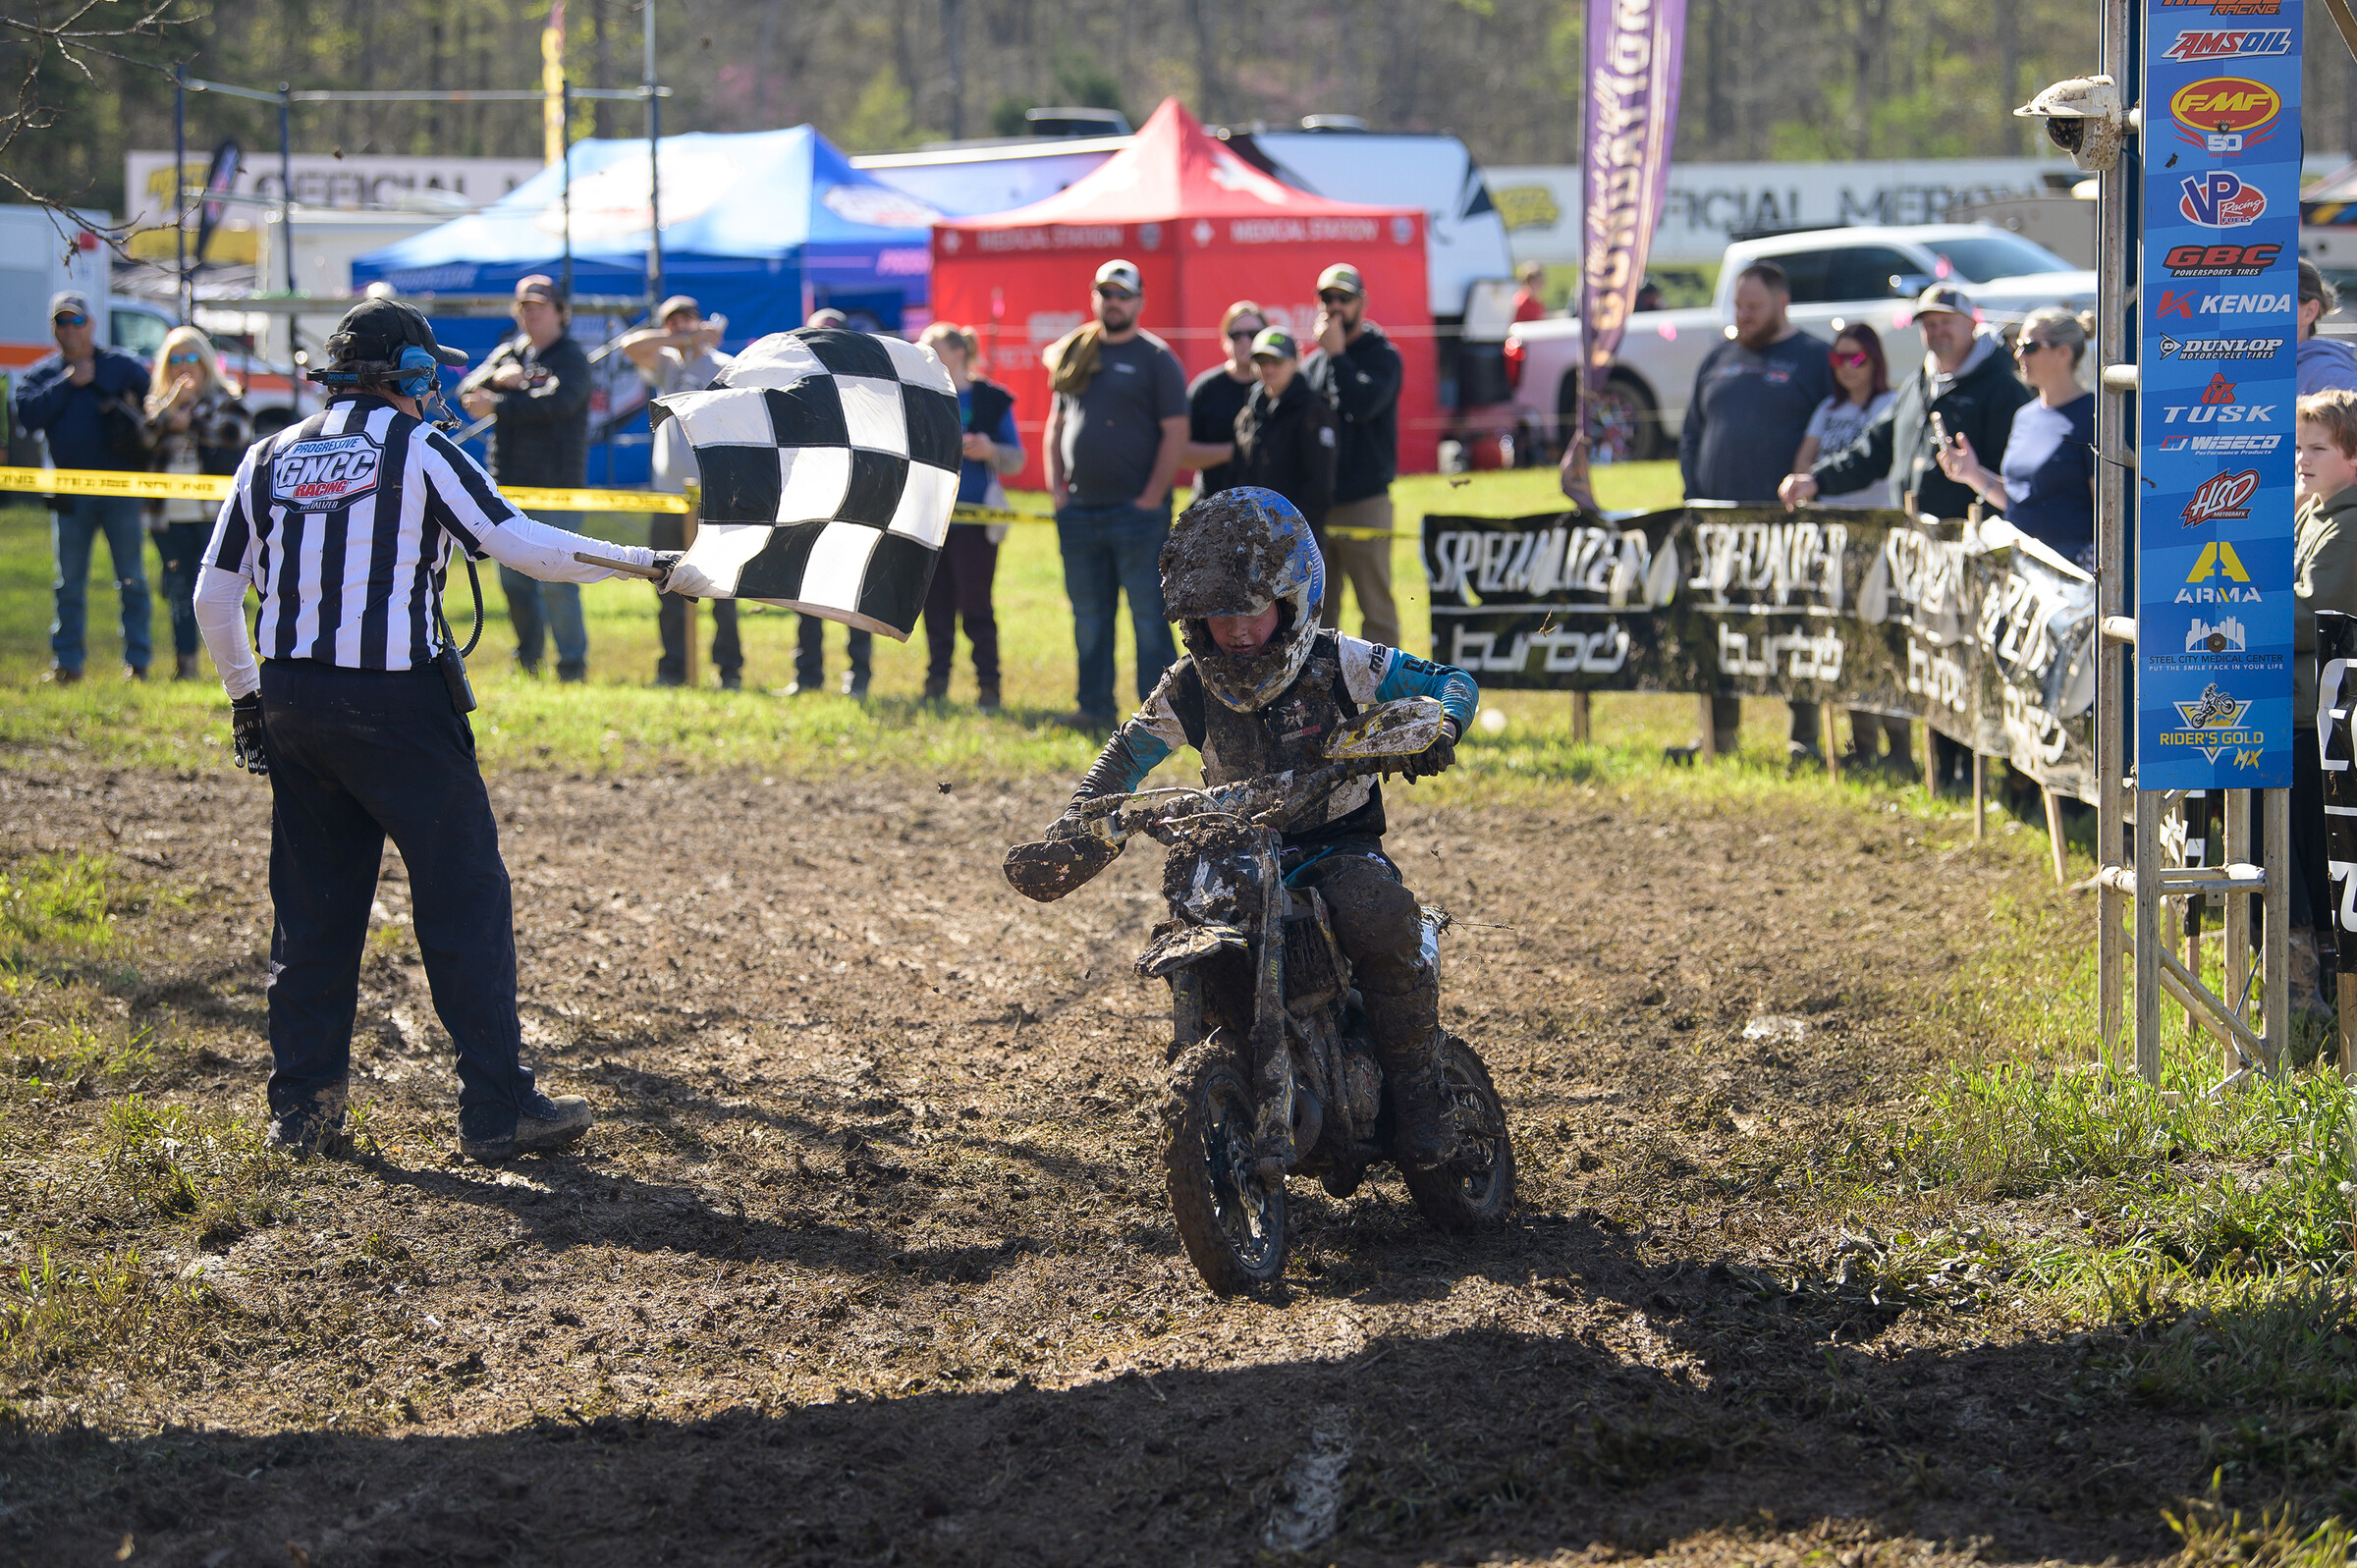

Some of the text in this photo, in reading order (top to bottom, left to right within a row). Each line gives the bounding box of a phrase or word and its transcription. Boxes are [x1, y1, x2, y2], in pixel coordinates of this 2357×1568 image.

[2211, 4, 2279, 15] RACING
[2165, 29, 2291, 62] AMSOIL
[2179, 92, 2272, 111] FMF
[2208, 135, 2242, 151] 50
[2181, 172, 2268, 226] VP Racing
[2164, 244, 2281, 267] GBC
[2199, 295, 2290, 313] KENDA
[2182, 339, 2284, 352] DUNLOP
[2179, 351, 2242, 360] MOTORCYCLE
[2163, 405, 2277, 423] TUSK
[293, 437, 359, 455] PROGRESSIVE
[277, 449, 377, 489] GNCC
[294, 479, 349, 498] RACING
[2173, 587, 2263, 604] ARMA
[2178, 655, 2199, 664] CITY
[2246, 654, 2283, 663] CENTER
[2160, 731, 2265, 745] RIDER'S GOLD
[2233, 747, 2265, 771] MX
